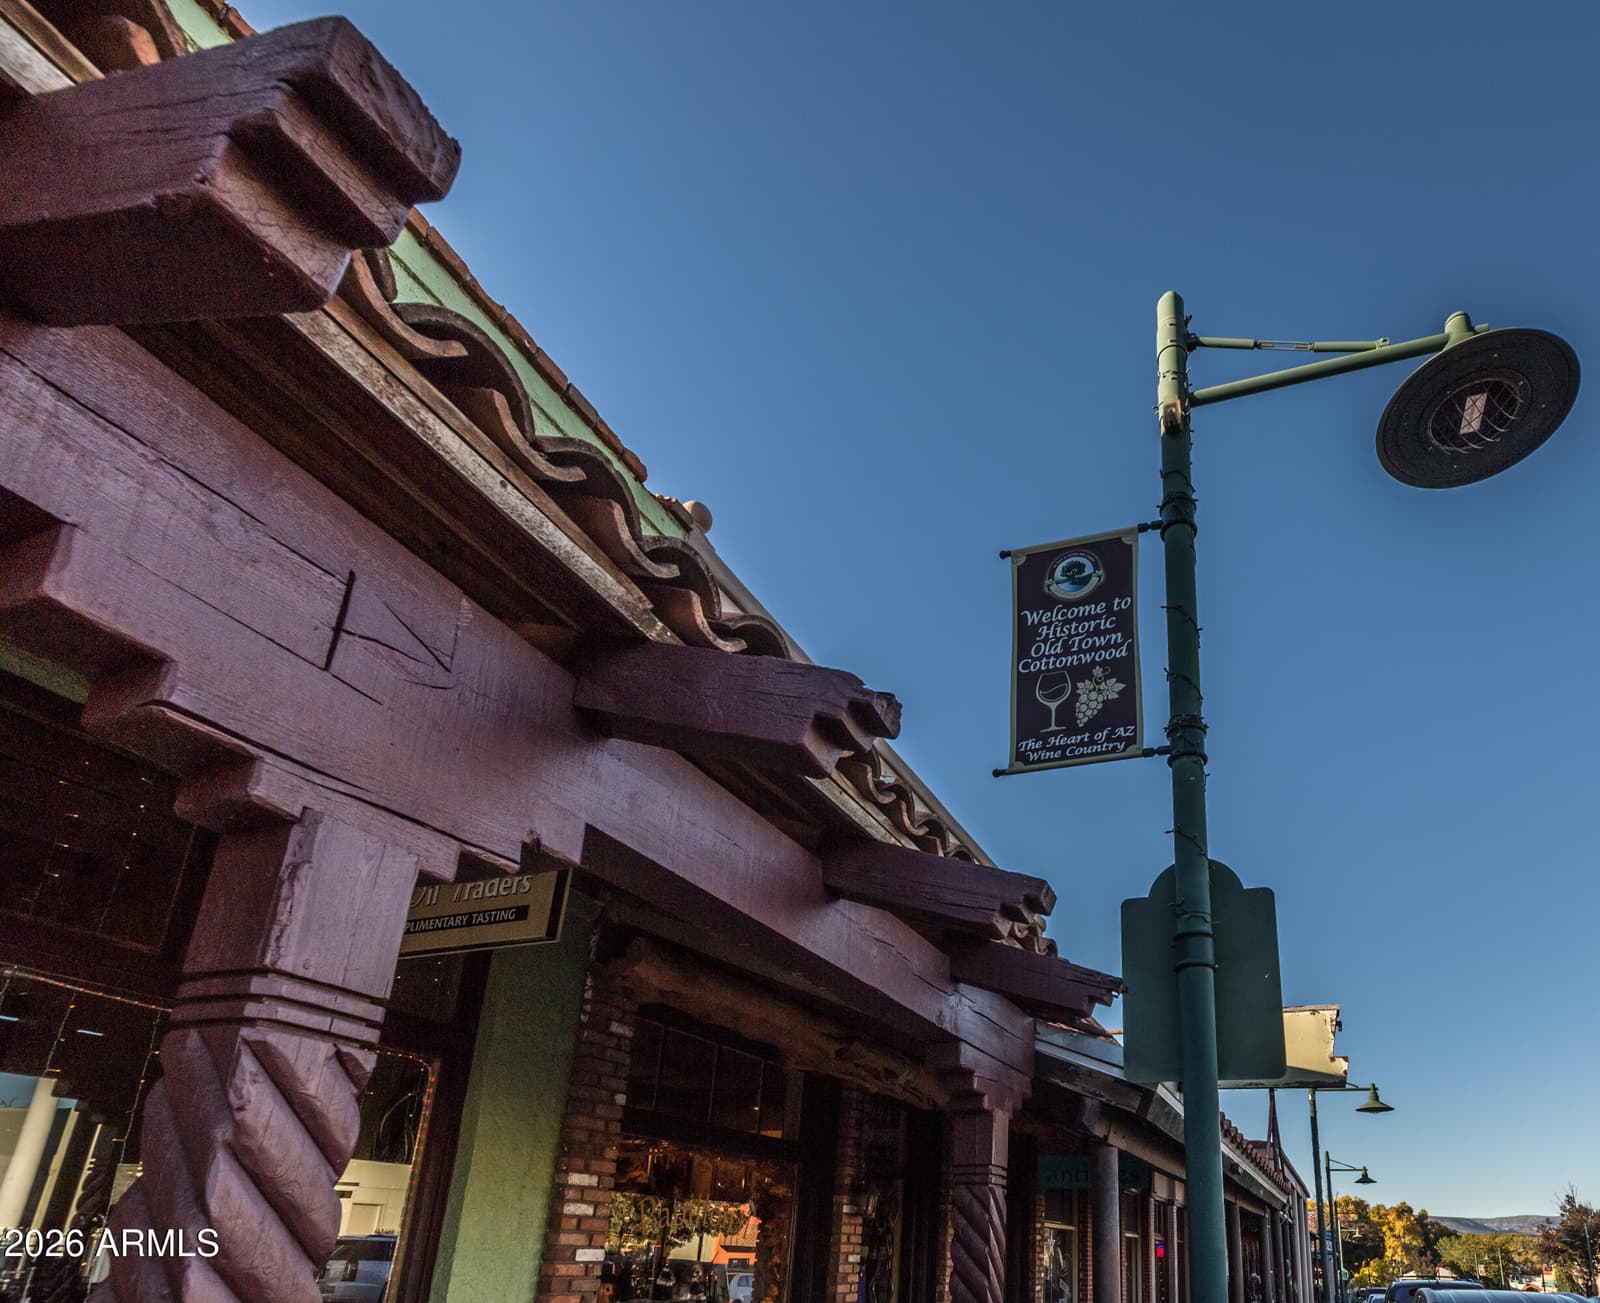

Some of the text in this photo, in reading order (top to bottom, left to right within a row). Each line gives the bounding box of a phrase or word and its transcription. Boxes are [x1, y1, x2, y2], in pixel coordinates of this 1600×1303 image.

[1021, 596, 1132, 626] Welcome to
[1038, 615, 1117, 640] Historic
[1018, 640, 1132, 673] Cottonwood
[1031, 632, 1124, 658] Old Town
[1018, 725, 1136, 752] The Heart of AZ
[1024, 740, 1126, 762] Wine Country
[405, 908, 517, 933] PLIMENTARY TASTING
